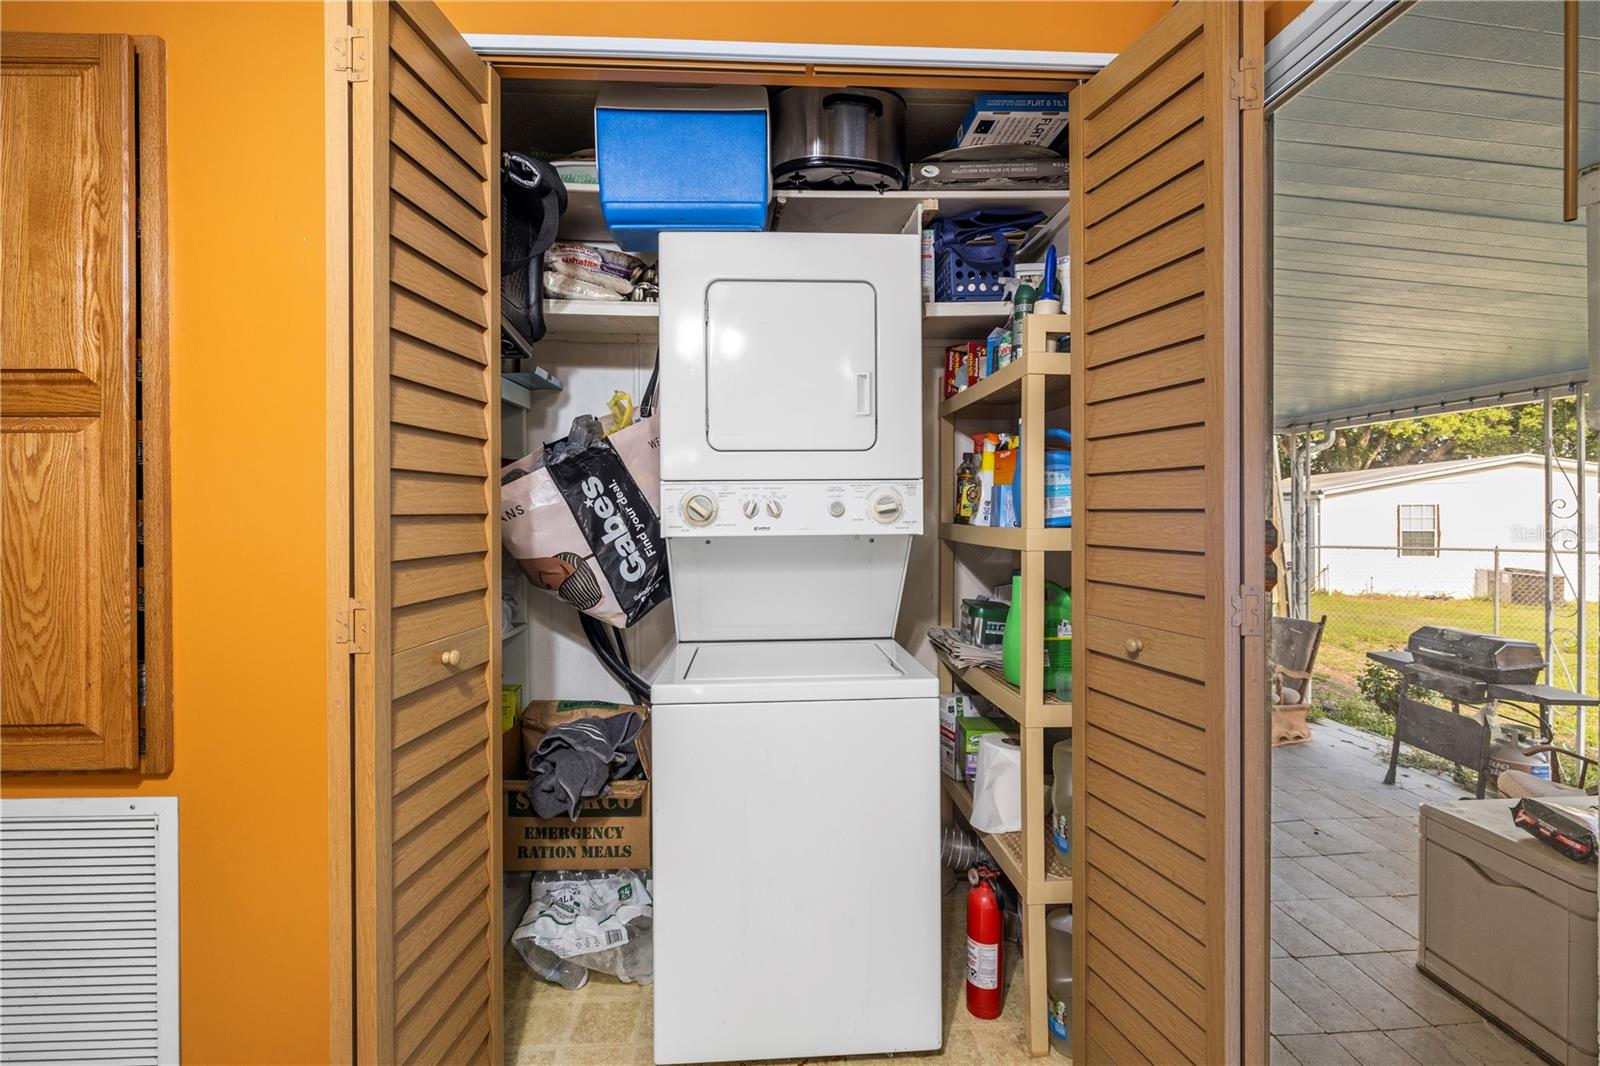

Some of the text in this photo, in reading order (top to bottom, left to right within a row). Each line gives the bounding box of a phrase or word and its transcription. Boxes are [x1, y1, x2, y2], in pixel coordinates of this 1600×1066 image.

[1027, 99, 1045, 107] FLAT
[1053, 99, 1067, 107] TILT
[1030, 117, 1053, 139] FLAT
[609, 478, 628, 505] deal.
[625, 507, 644, 532] your
[637, 532, 656, 557] Find
[524, 826, 625, 840] EMERGENCY
[517, 845, 632, 859] RATION MEALS
